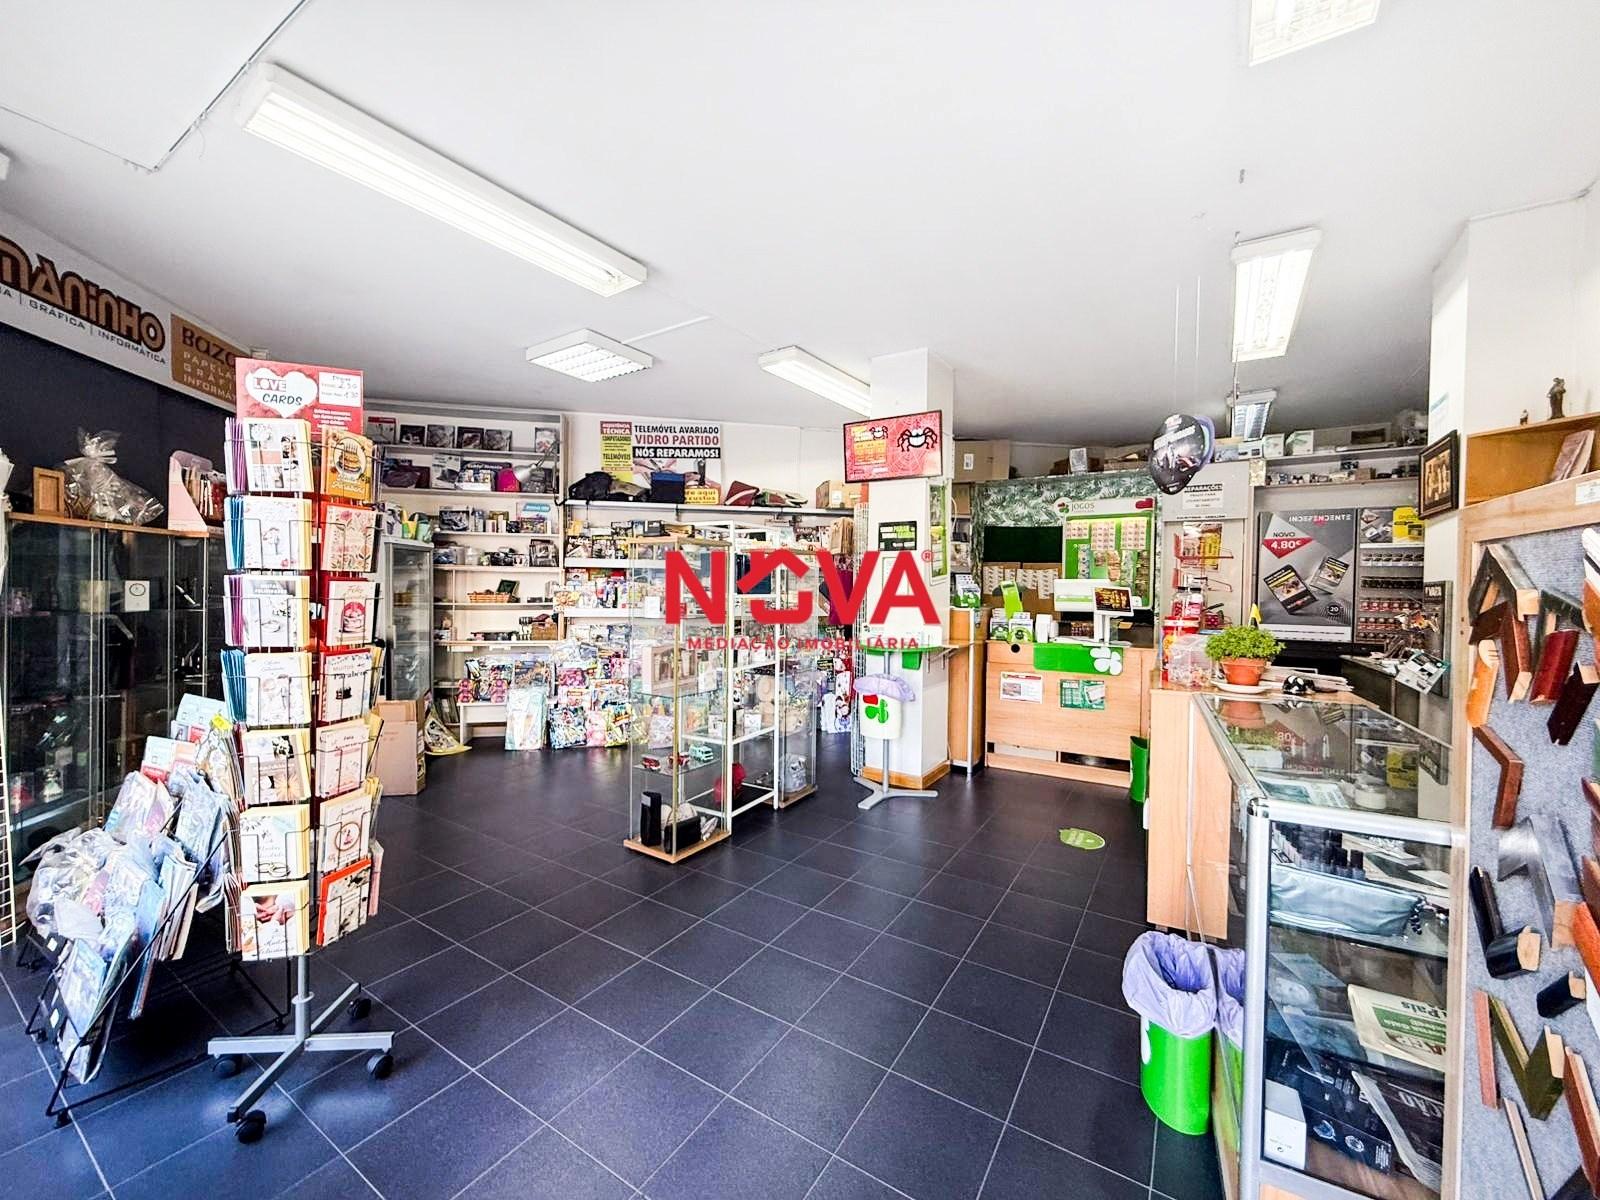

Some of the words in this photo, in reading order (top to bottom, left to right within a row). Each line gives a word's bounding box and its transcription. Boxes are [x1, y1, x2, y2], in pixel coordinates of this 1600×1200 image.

[29, 299, 86, 331] GRÁFICA
[98, 330, 166, 365] INFORMÁTICA
[253, 377, 287, 393] LOVE
[262, 393, 303, 406] CARDS
[634, 424, 677, 434] TELEMÓVEL
[679, 426, 719, 434] AVARIADO
[634, 434, 669, 445] VIDRO
[672, 435, 719, 446] PARTIDO
[602, 452, 631, 460] TELEMÓVEIS
[635, 447, 655, 457] NÓS
[656, 448, 719, 458] REPARAMOS!
[1071, 501, 1095, 512] JOGOS
